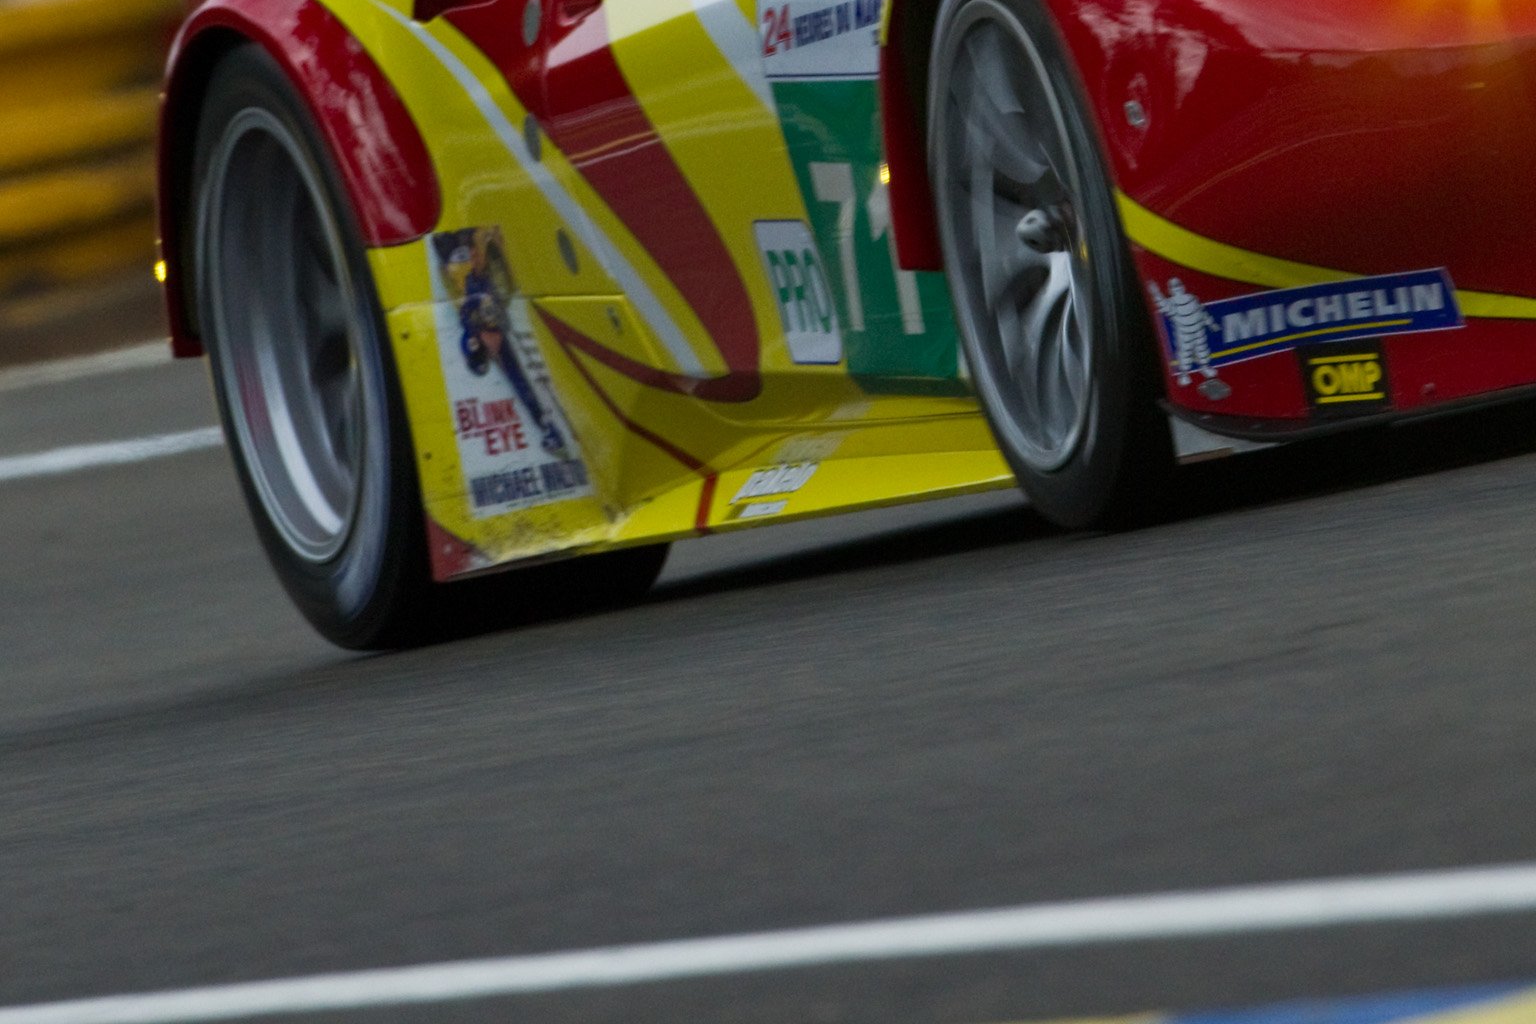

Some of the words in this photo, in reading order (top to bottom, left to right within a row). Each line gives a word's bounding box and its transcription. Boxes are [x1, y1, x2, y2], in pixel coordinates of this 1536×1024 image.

[762, 3, 792, 58] 24
[809, 161, 926, 335] 71
[766, 248, 832, 335] PRO
[1222, 281, 1446, 344] MICHELIN
[1312, 360, 1383, 396] OMP
[456, 398, 520, 433] BLINK
[485, 423, 528, 456] EYE
